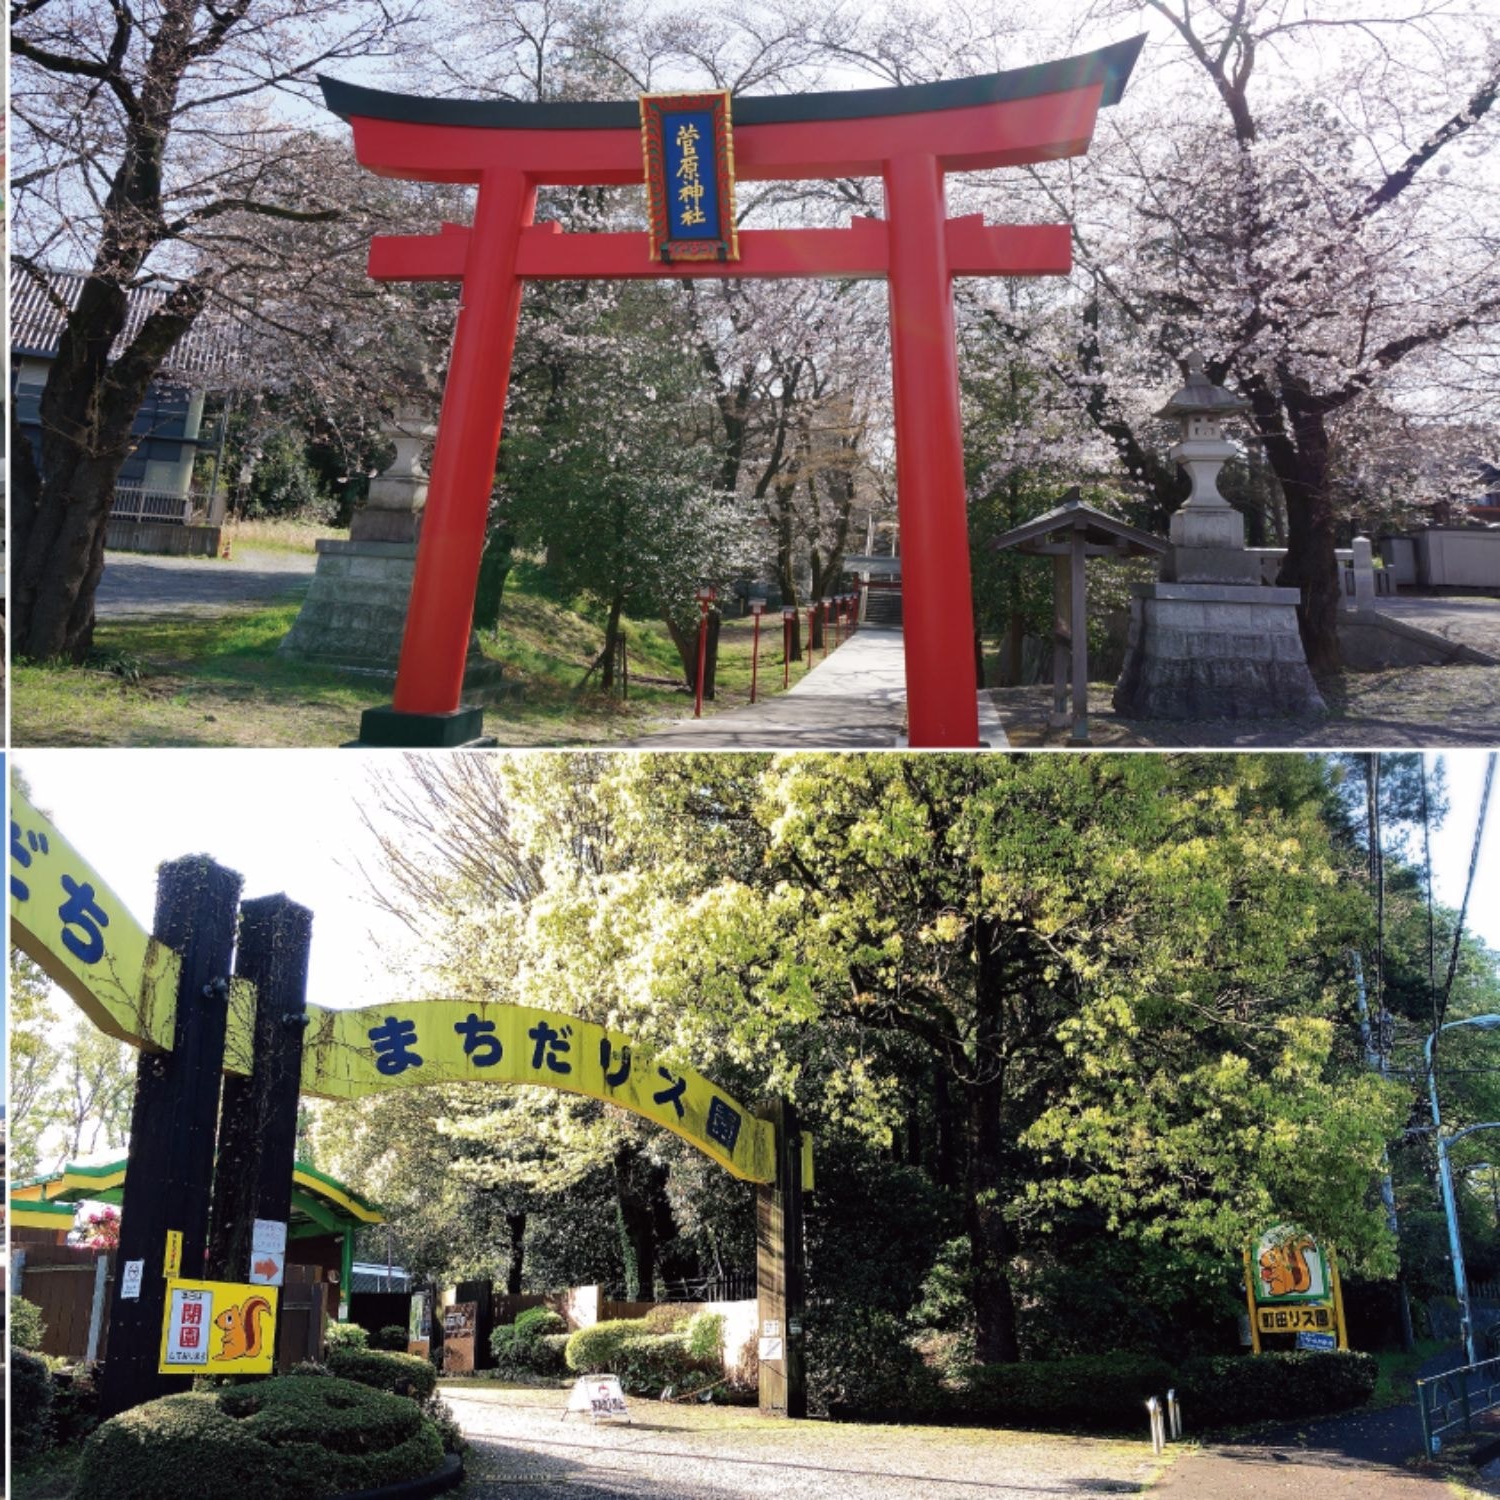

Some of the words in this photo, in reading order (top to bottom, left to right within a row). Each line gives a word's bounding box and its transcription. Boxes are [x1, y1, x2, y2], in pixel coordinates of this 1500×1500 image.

[676, 123, 706, 226] 菅原神社
[368, 1012, 742, 1152] まちだリス園
